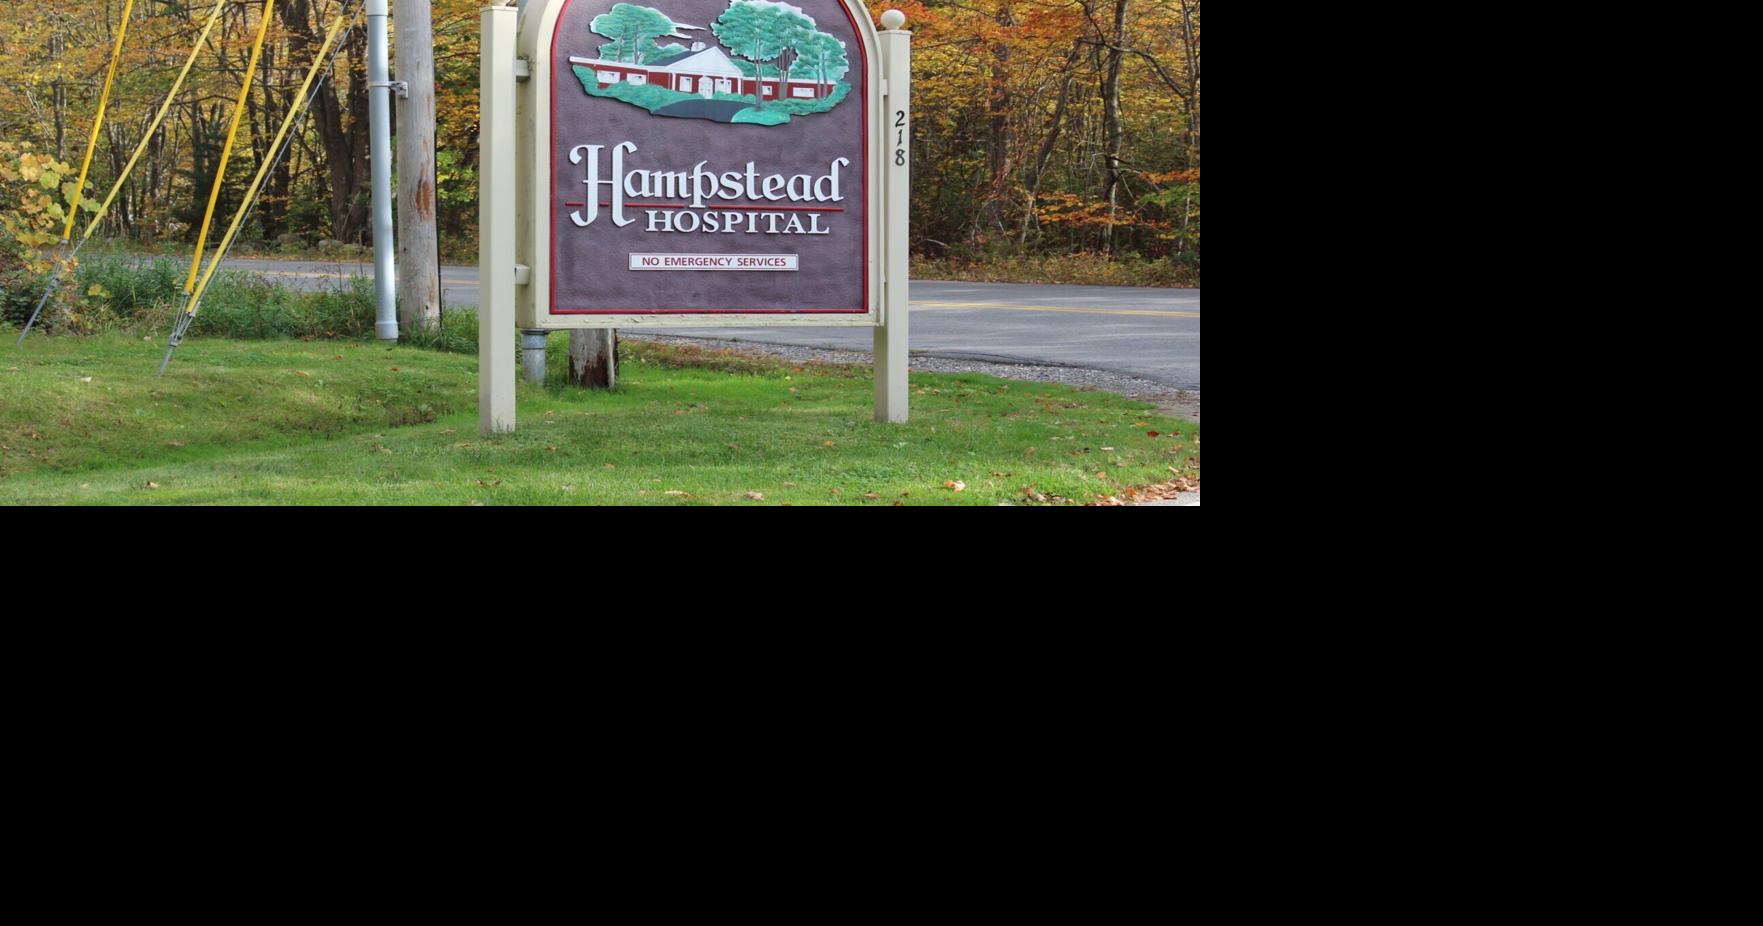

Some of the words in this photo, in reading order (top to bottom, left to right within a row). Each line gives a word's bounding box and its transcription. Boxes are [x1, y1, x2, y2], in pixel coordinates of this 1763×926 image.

[895, 110, 906, 166] 218
[568, 141, 850, 227] Hampstead
[645, 210, 830, 235] HOSPITAL
[642, 256, 660, 267] NO
[664, 256, 733, 267] EMERGENCY
[737, 257, 787, 267] SERVICES
